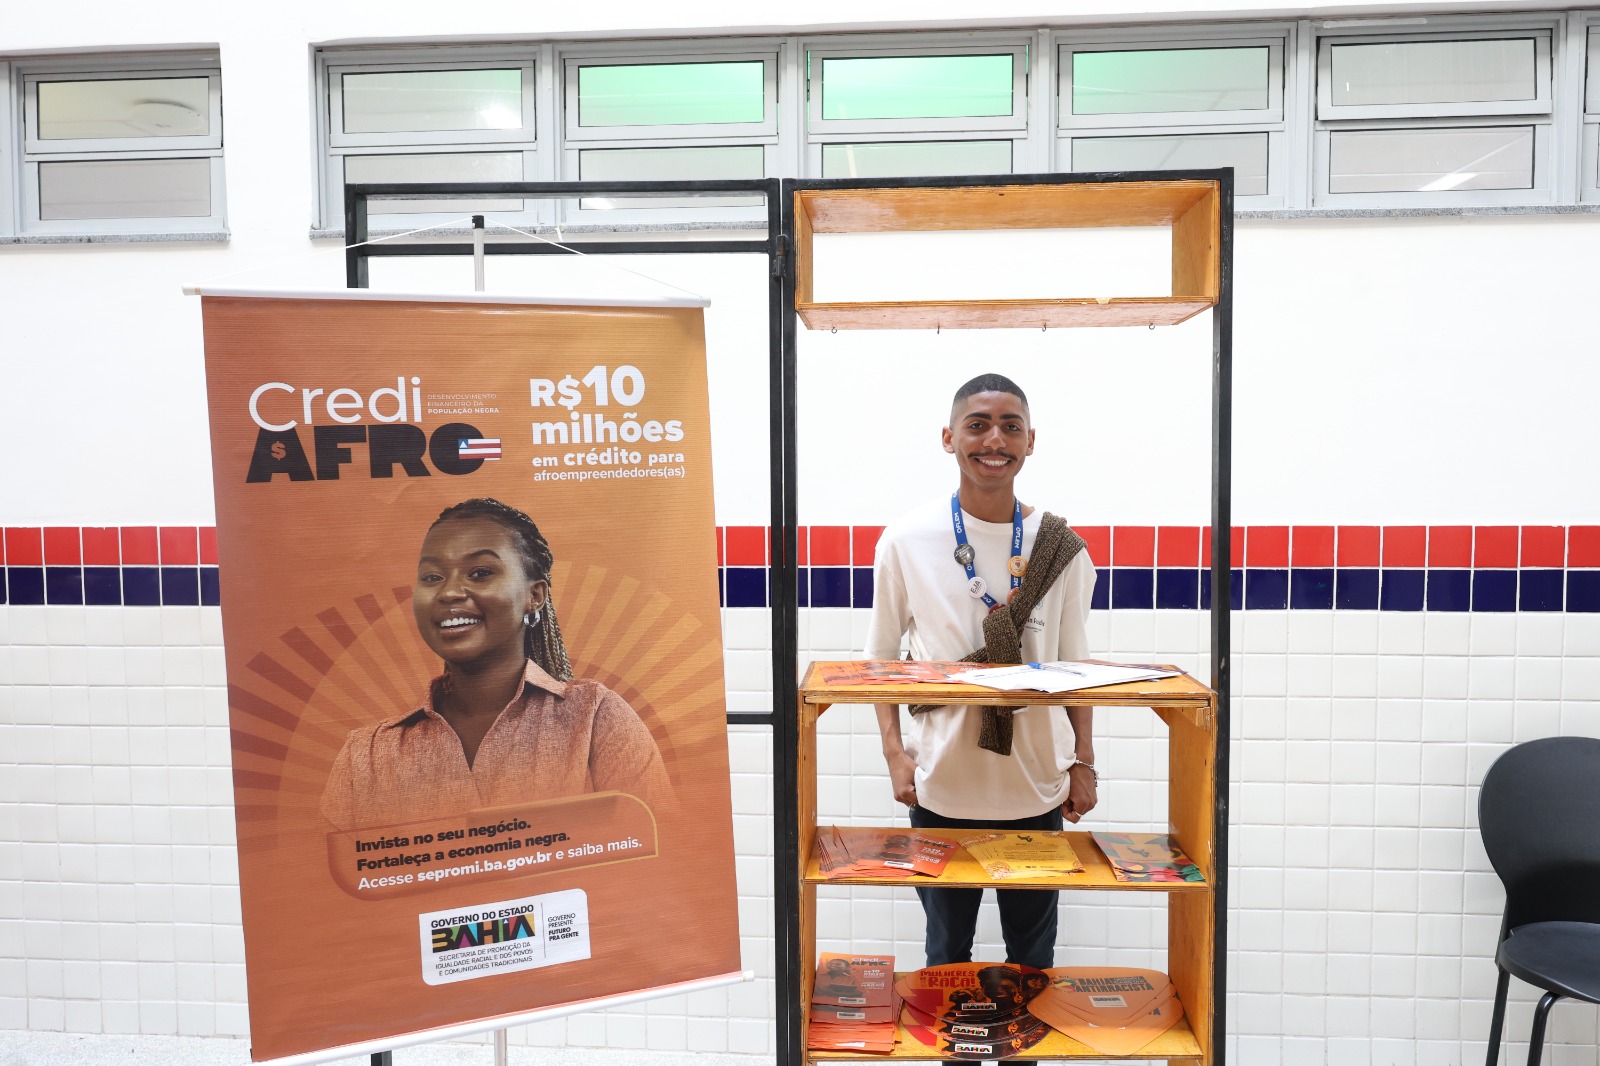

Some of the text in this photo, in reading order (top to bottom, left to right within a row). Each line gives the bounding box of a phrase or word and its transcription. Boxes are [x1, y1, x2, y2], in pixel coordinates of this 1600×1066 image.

[530, 365, 645, 410] R$10
[249, 376, 422, 432] Credi
[532, 411, 684, 445] milhões
[246, 423, 485, 483] AFRO
[532, 447, 684, 467] em crédito para
[534, 466, 686, 482] afroempreendedores(as)
[970, 580, 981, 594] EJA
[356, 818, 531, 852] Invista no seu negócio.
[357, 832, 570, 871] Fortaleça a economia negra.
[358, 837, 642, 890] Acesse sepromi.ba.gov.br e saiba mais.
[431, 904, 534, 928] GOVERNO DO ESTADO
[548, 913, 576, 922] GOVERNO
[548, 919, 573, 928] PRESENTE
[432, 914, 535, 953] BAHIA
[548, 927, 571, 936] FUTURO
[548, 931, 579, 942] PRA GENTE
[435, 959, 470, 969] IGUALDADE
[513, 948, 533, 956] POVOS
[439, 951, 476, 961] SECRETARIA
[487, 943, 521, 954] PROMOÇÃO
[444, 963, 489, 975] COMUNIDADES
[491, 956, 532, 967] TRADICIONAIS
